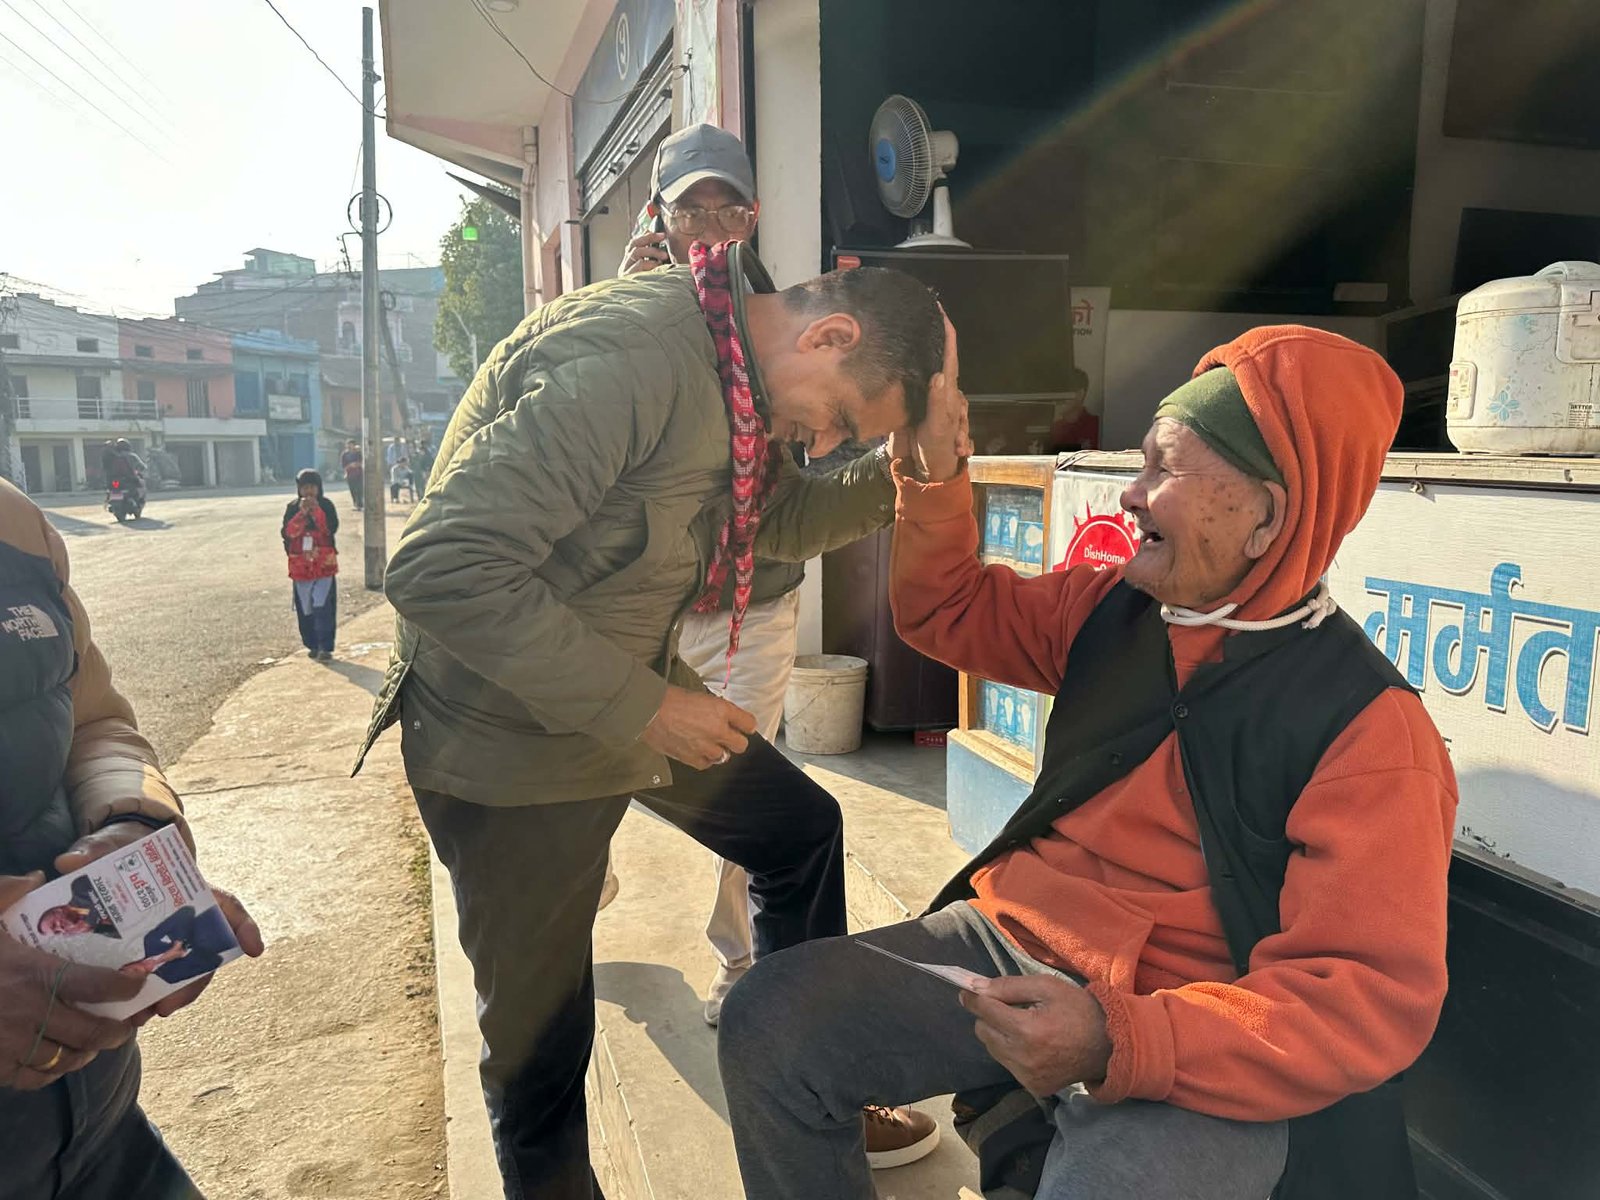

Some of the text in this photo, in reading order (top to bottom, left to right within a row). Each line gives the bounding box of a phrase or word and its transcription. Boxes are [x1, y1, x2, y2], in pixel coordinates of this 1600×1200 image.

[1084, 544, 1126, 565] DishHome
[7, 606, 33, 618] THE
[1, 616, 39, 633] NORTH
[1364, 562, 1600, 735] मर्मत
